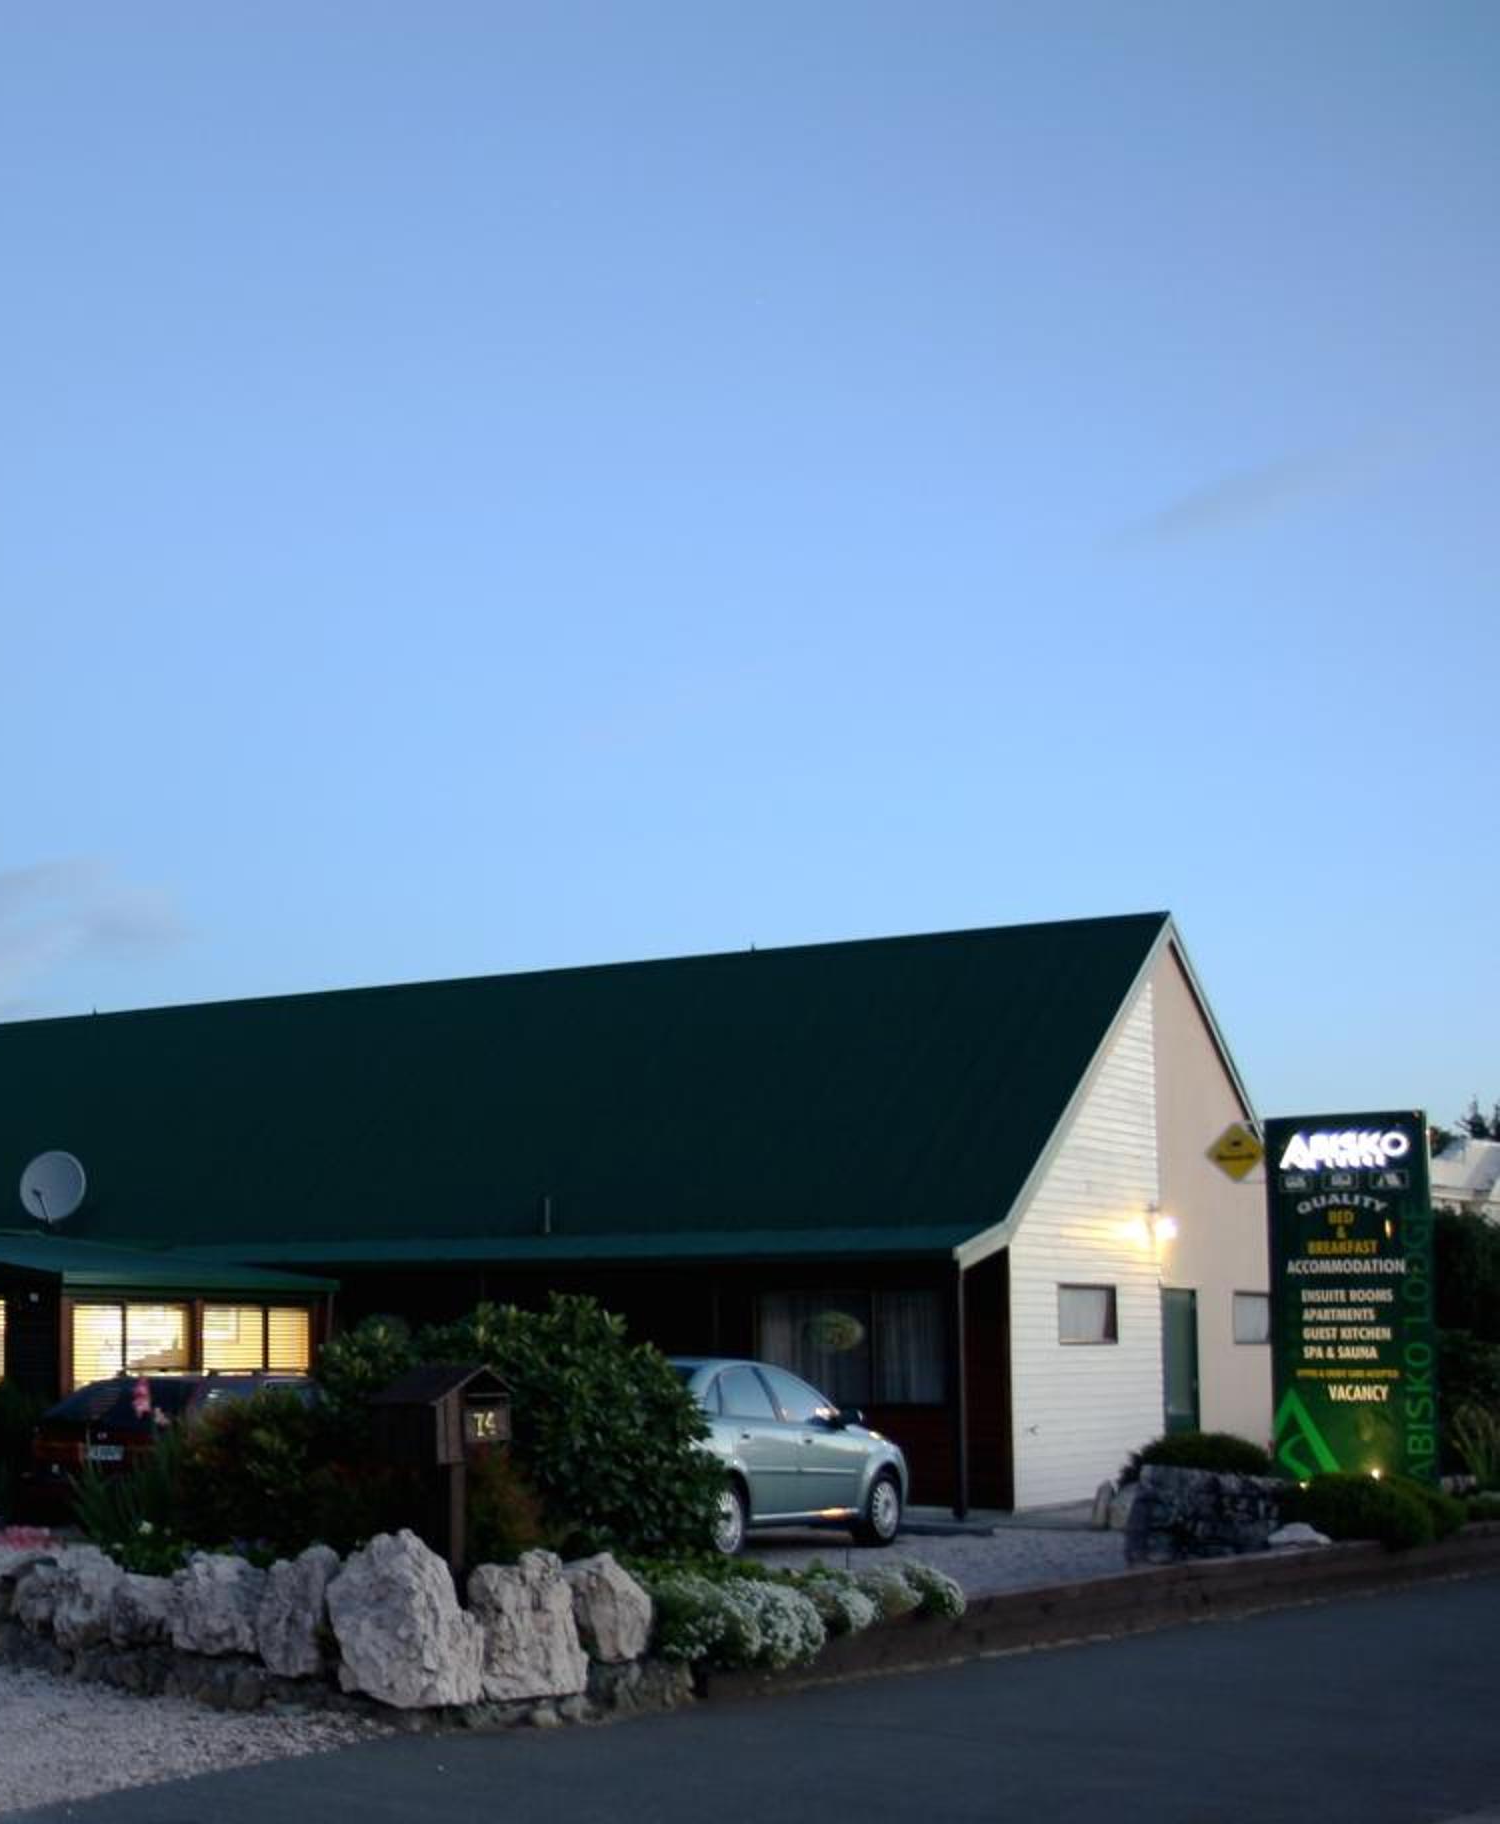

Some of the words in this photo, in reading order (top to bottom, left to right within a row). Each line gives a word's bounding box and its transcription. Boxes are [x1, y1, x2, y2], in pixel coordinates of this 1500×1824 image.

[1296, 1193, 1388, 1214] QUALITY
[1328, 1210, 1355, 1224] BED
[1307, 1240, 1378, 1254] BREAKFAST
[1286, 1259, 1406, 1274] ACCOMMODATION
[1301, 1289, 1346, 1303] ENSUITE
[1350, 1289, 1393, 1302] ROOMS
[1302, 1308, 1376, 1321] APARTMENTS
[1303, 1327, 1337, 1340] GUEST
[1340, 1327, 1392, 1340] KITCHEN
[1303, 1346, 1323, 1359] SPA
[1337, 1346, 1378, 1359] SAUNA
[1328, 1385, 1389, 1401] VACANCY
